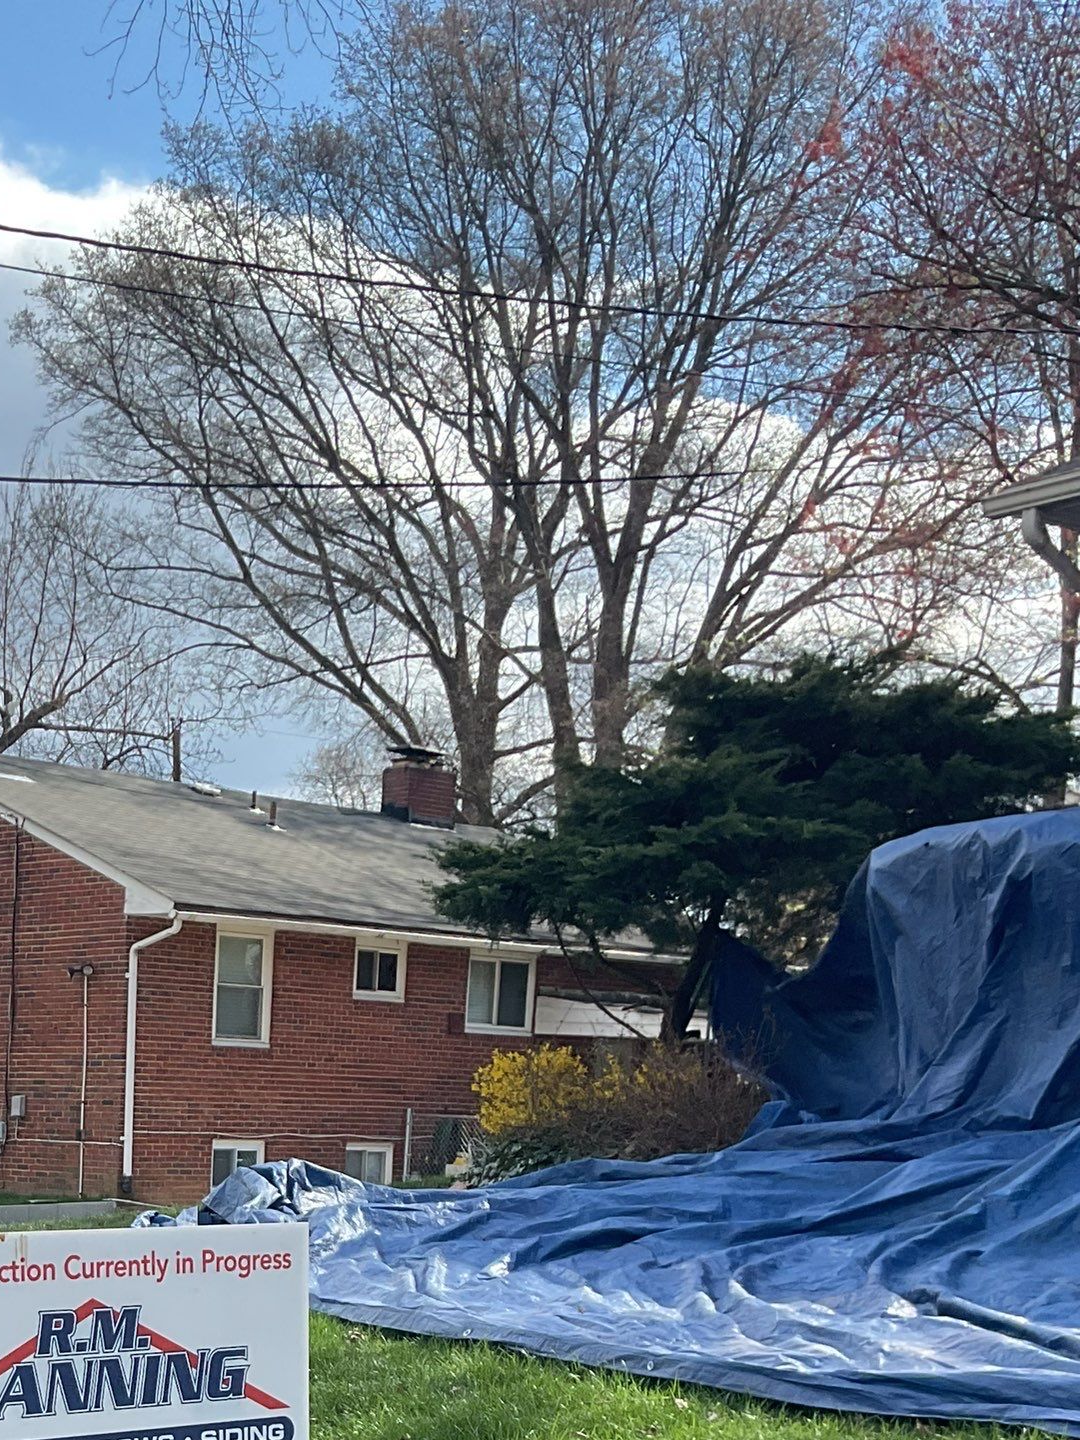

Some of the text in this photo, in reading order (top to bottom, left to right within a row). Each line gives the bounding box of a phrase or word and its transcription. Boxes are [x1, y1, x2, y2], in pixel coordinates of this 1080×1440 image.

[64, 1251, 168, 1282] Currently
[176, 1251, 193, 1274] in
[203, 1250, 291, 1276] Progress
[34, 1304, 152, 1358] R.M.
